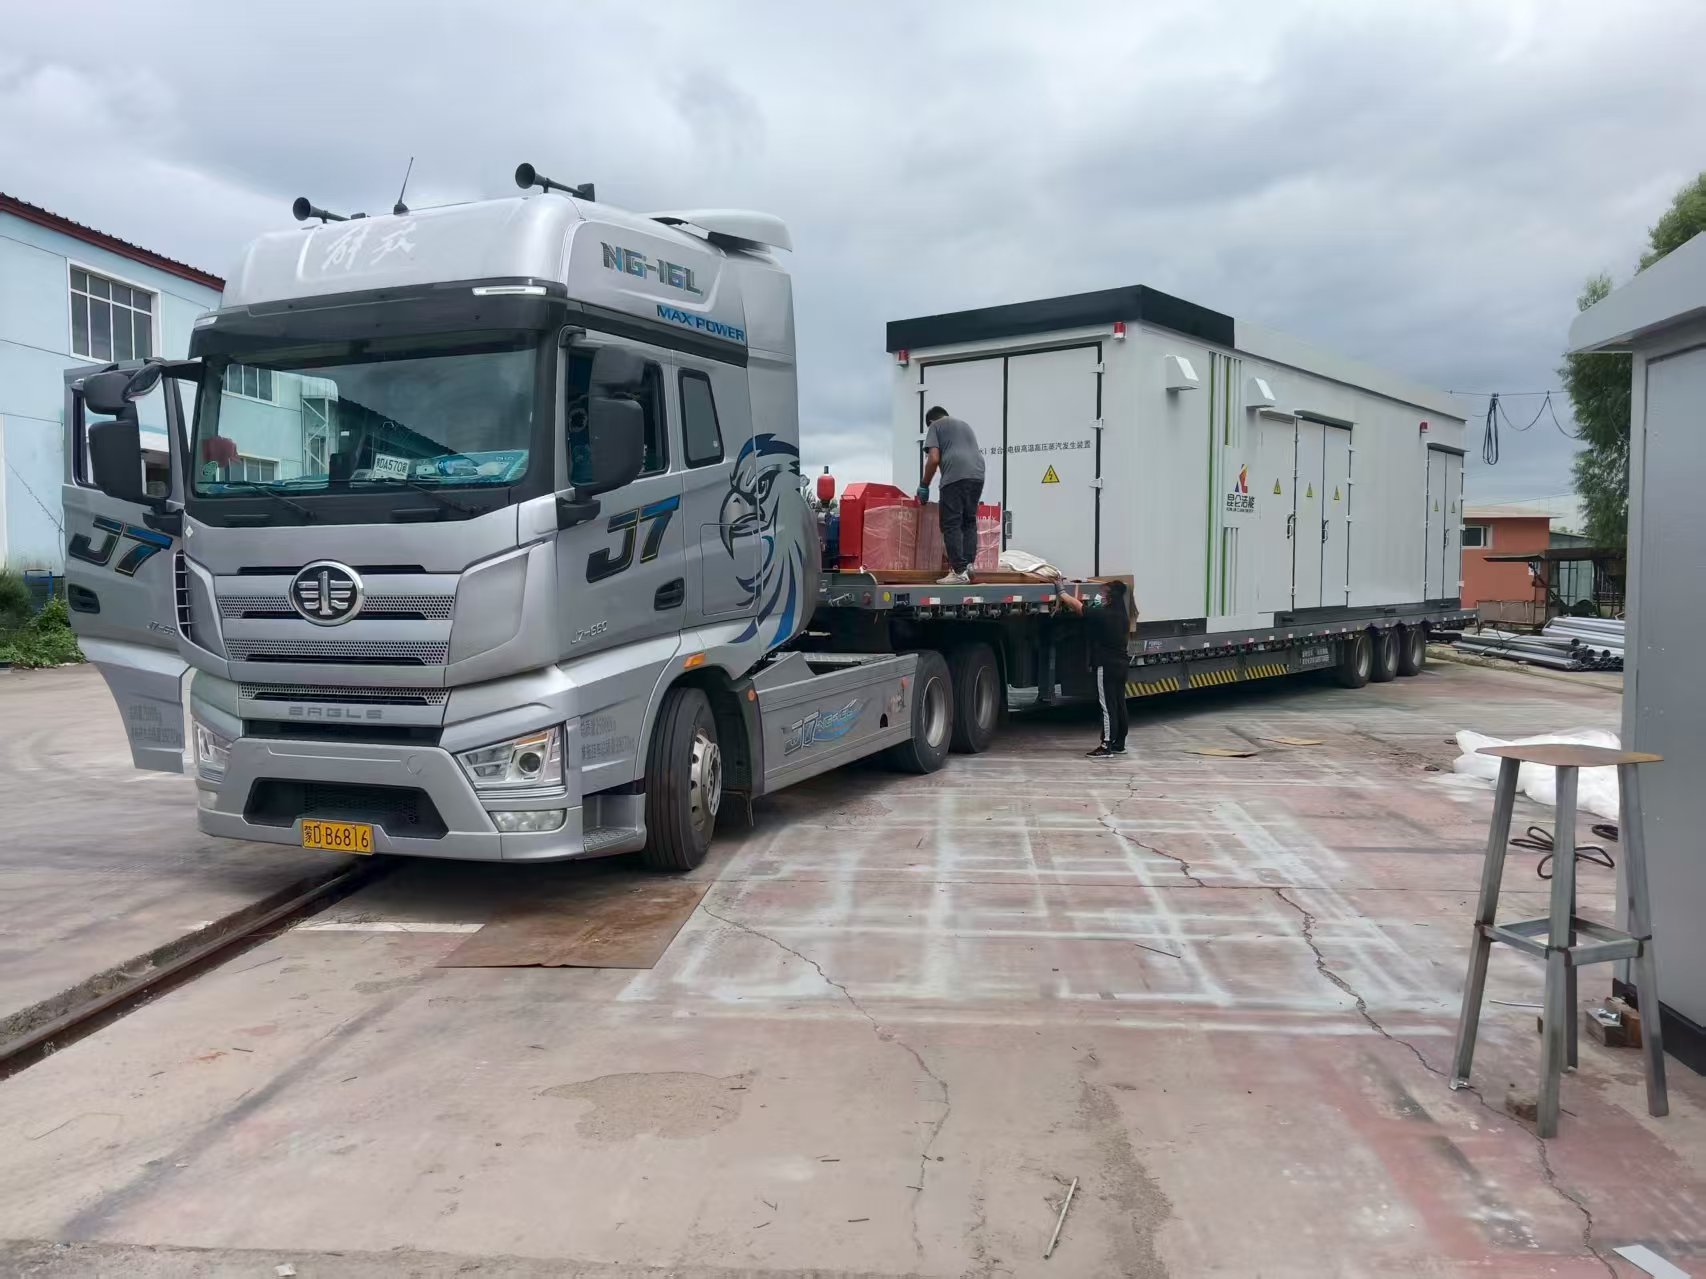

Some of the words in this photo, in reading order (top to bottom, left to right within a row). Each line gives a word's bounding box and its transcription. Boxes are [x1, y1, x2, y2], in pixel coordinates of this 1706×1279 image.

[600, 241, 704, 297] NG-16L
[656, 304, 693, 327] MAX
[696, 316, 746, 342] POWER
[68, 514, 174, 578] J7
[585, 494, 681, 584] J7
[288, 706, 383, 720] EAGLE
